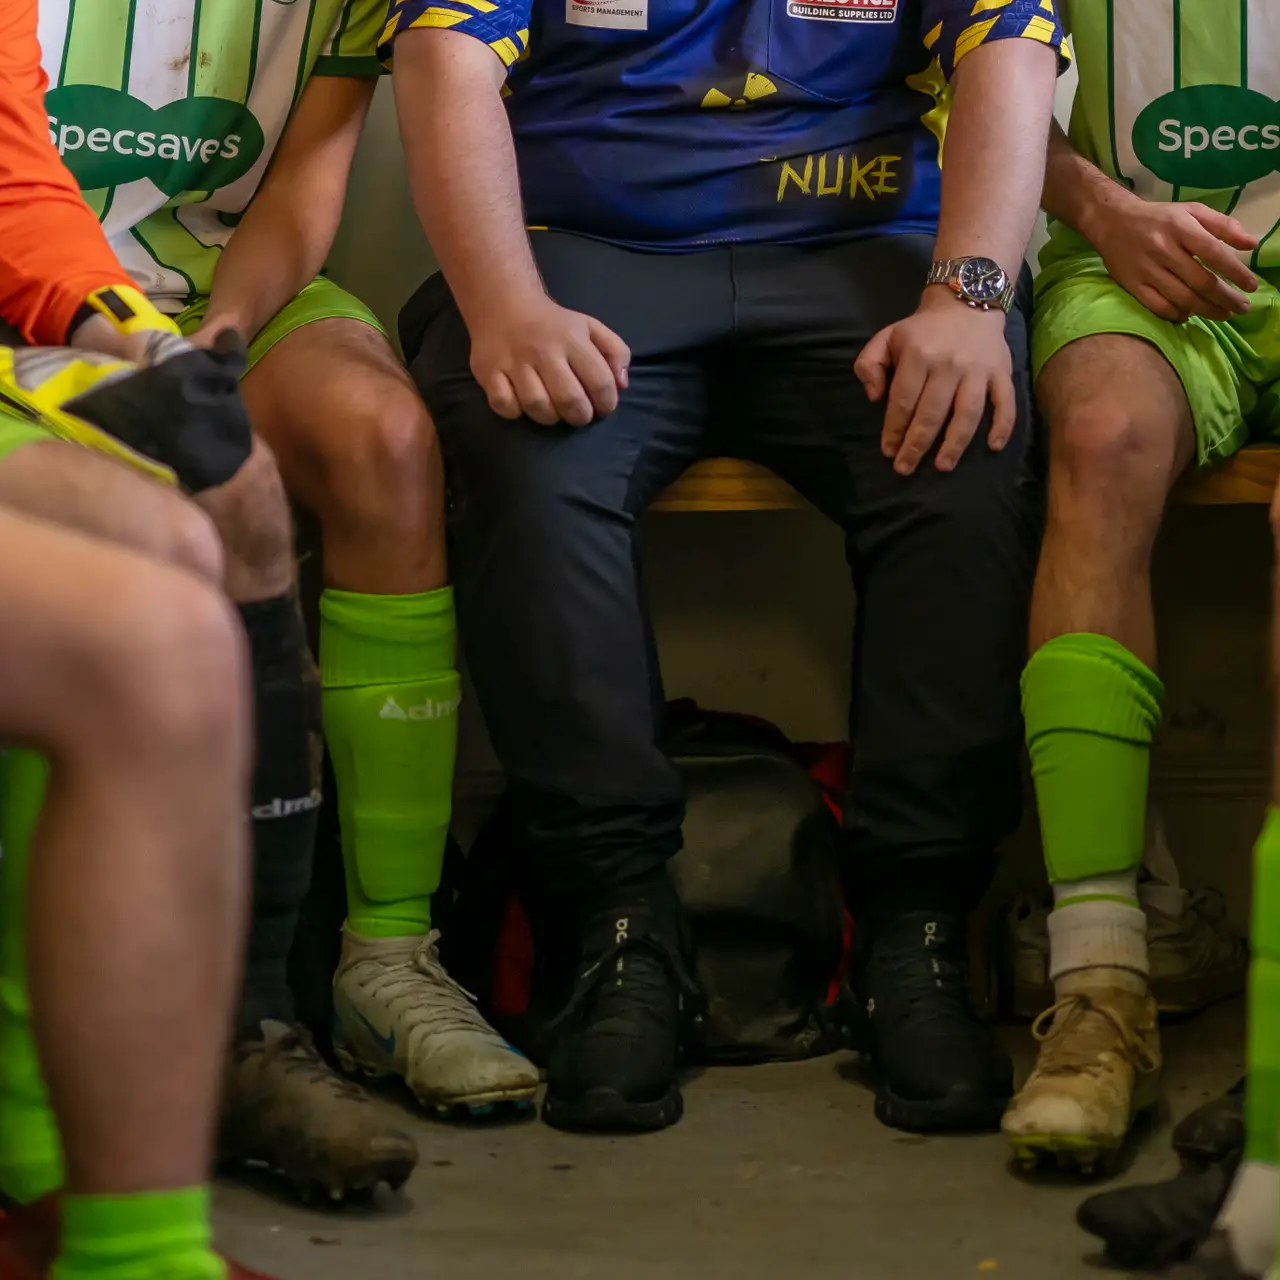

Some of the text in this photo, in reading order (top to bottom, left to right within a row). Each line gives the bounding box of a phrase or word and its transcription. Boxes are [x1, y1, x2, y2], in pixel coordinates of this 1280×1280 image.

[571, 4, 644, 17] SPORTS MANAGEMENT
[792, 4, 893, 20] BUILDING SUPPLIES LTD
[776, 151, 903, 203] NUKE
